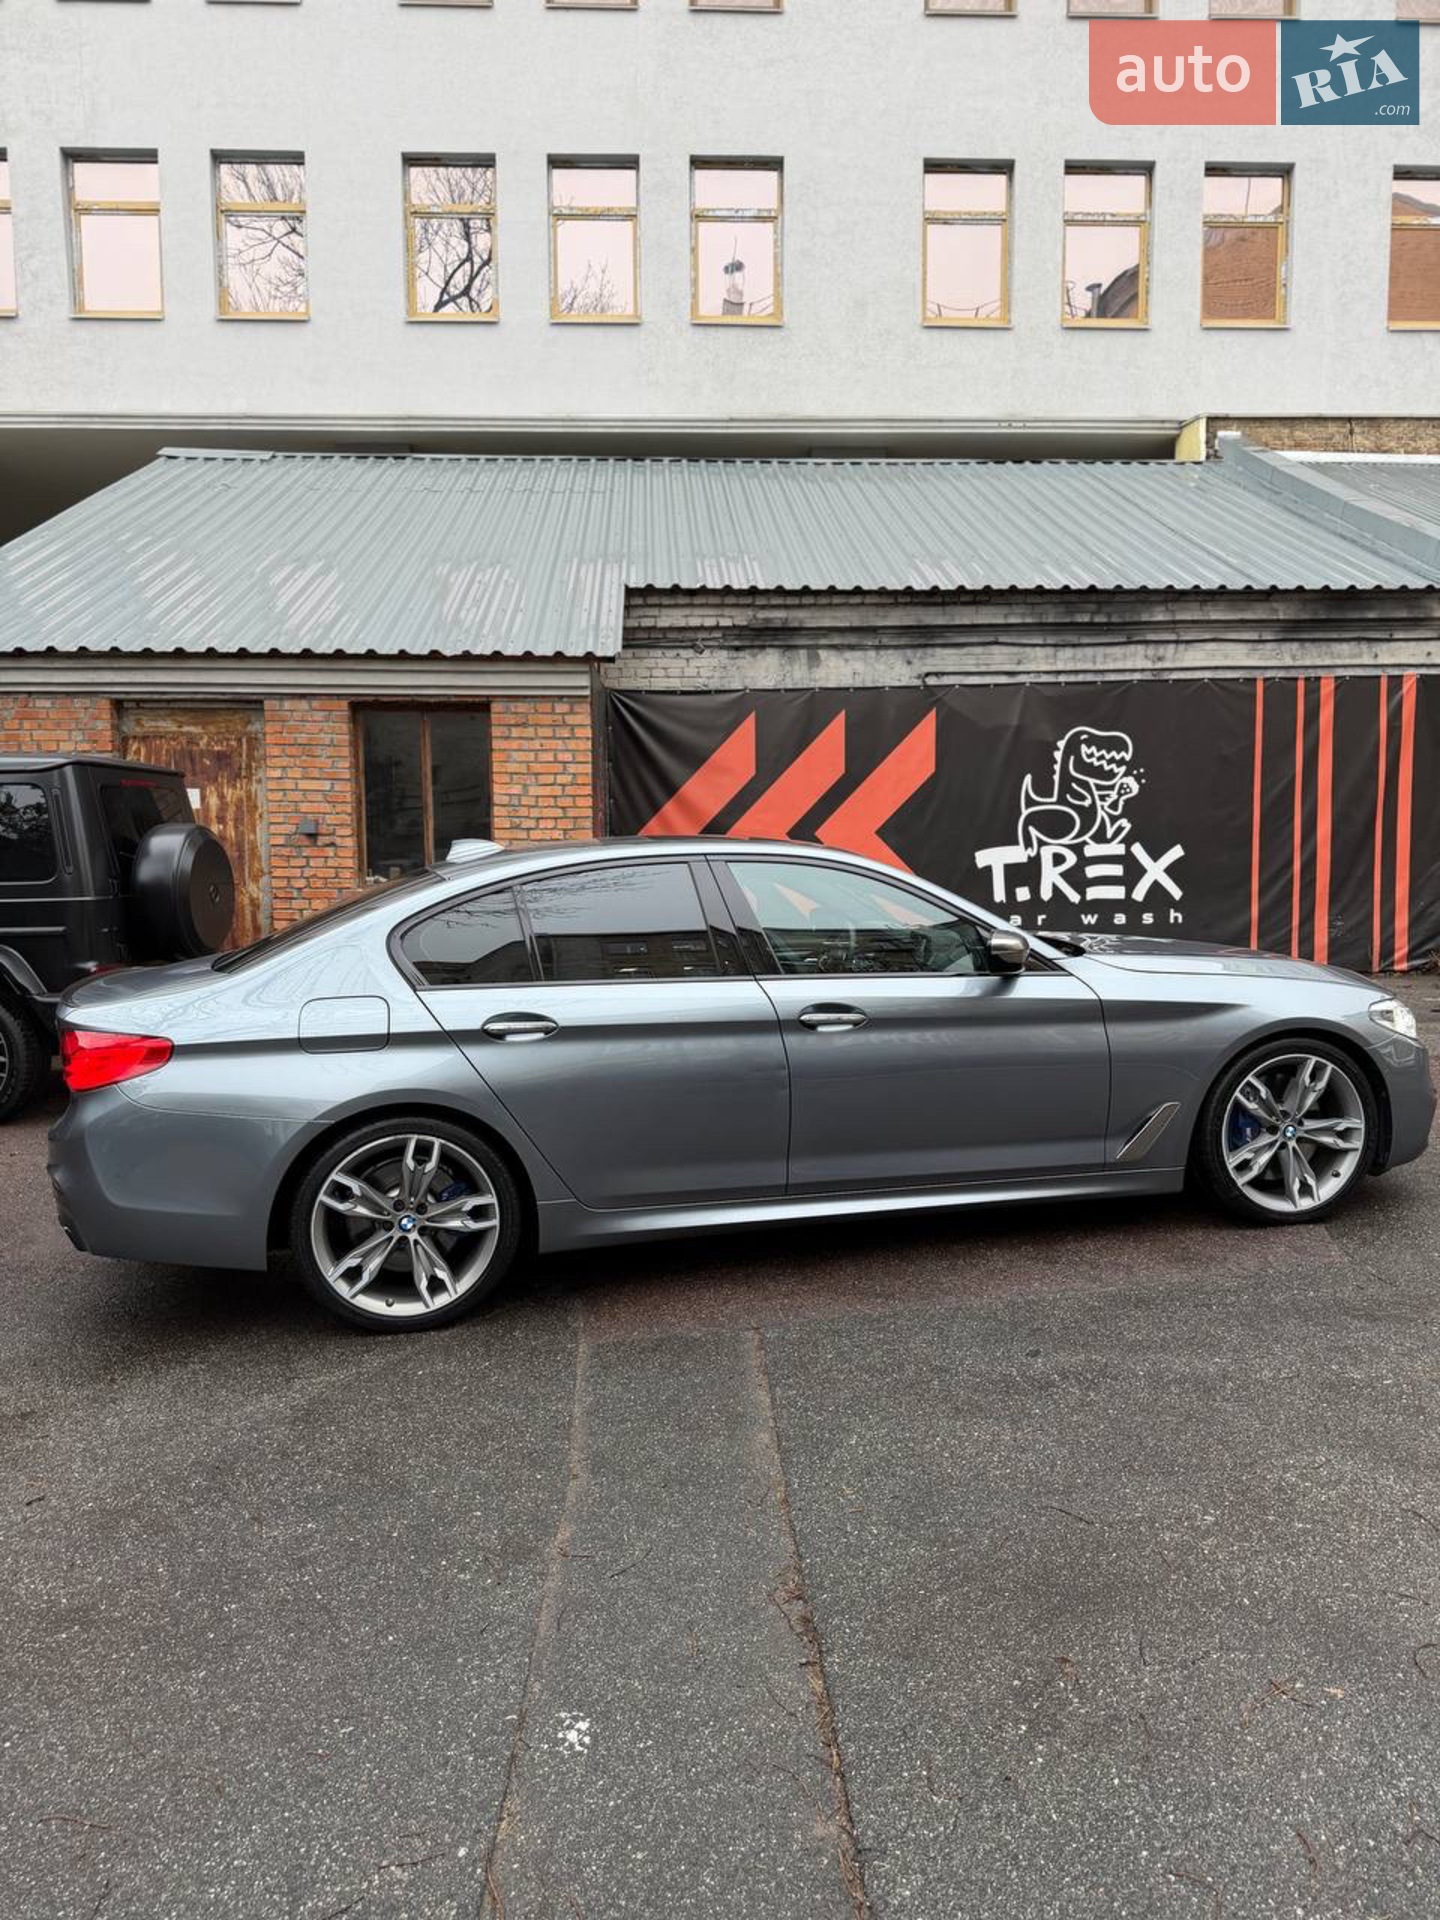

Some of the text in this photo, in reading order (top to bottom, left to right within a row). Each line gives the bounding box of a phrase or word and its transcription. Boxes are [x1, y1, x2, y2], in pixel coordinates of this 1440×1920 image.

[974, 841, 1185, 904] T.REX
[1009, 908, 1183, 926] ar wash
